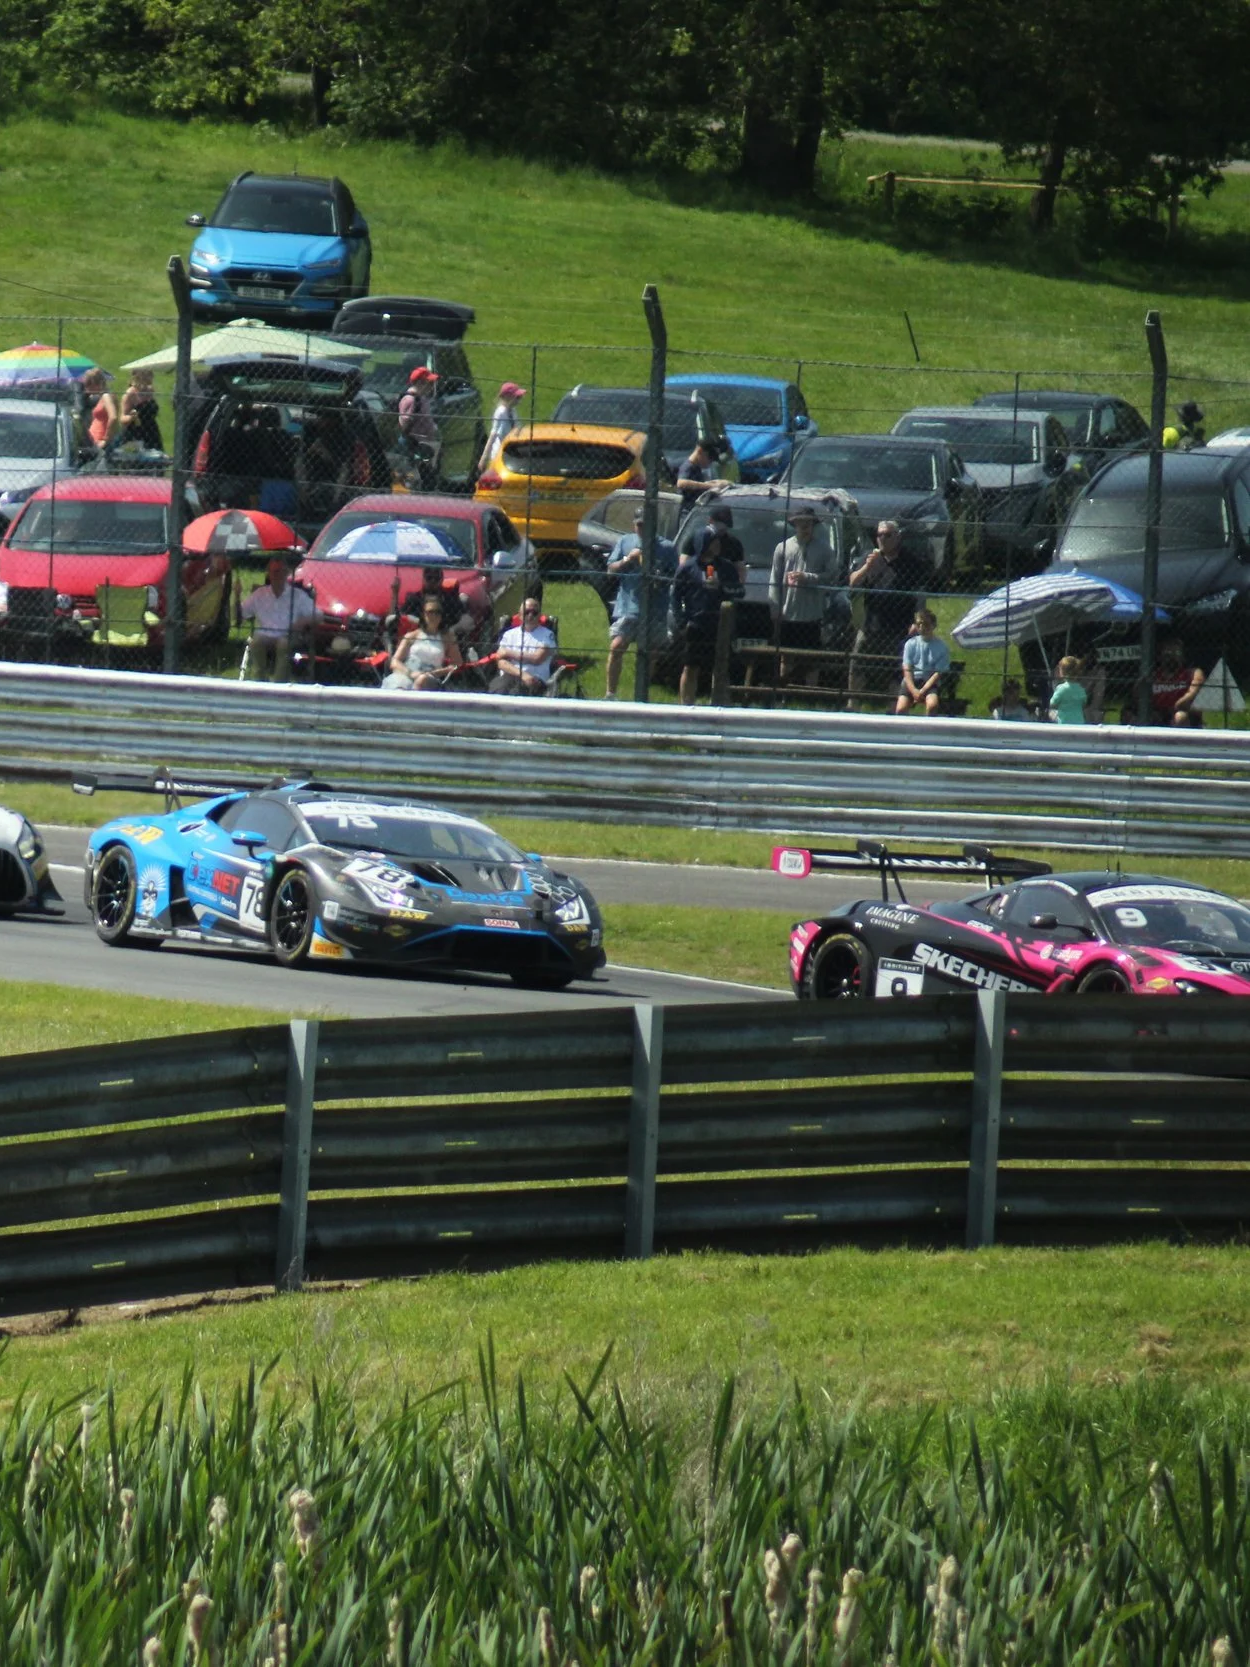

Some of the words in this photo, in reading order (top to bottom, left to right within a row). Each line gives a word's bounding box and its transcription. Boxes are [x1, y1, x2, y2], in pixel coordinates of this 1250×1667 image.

[323, 814, 378, 829] 78
[355, 864, 407, 883] 78
[245, 883, 265, 920] 78
[865, 906, 920, 925] IMAGINE
[870, 918, 900, 931] CRUISING
[1115, 907, 1148, 928] 9
[912, 943, 1043, 993] SKECHER
